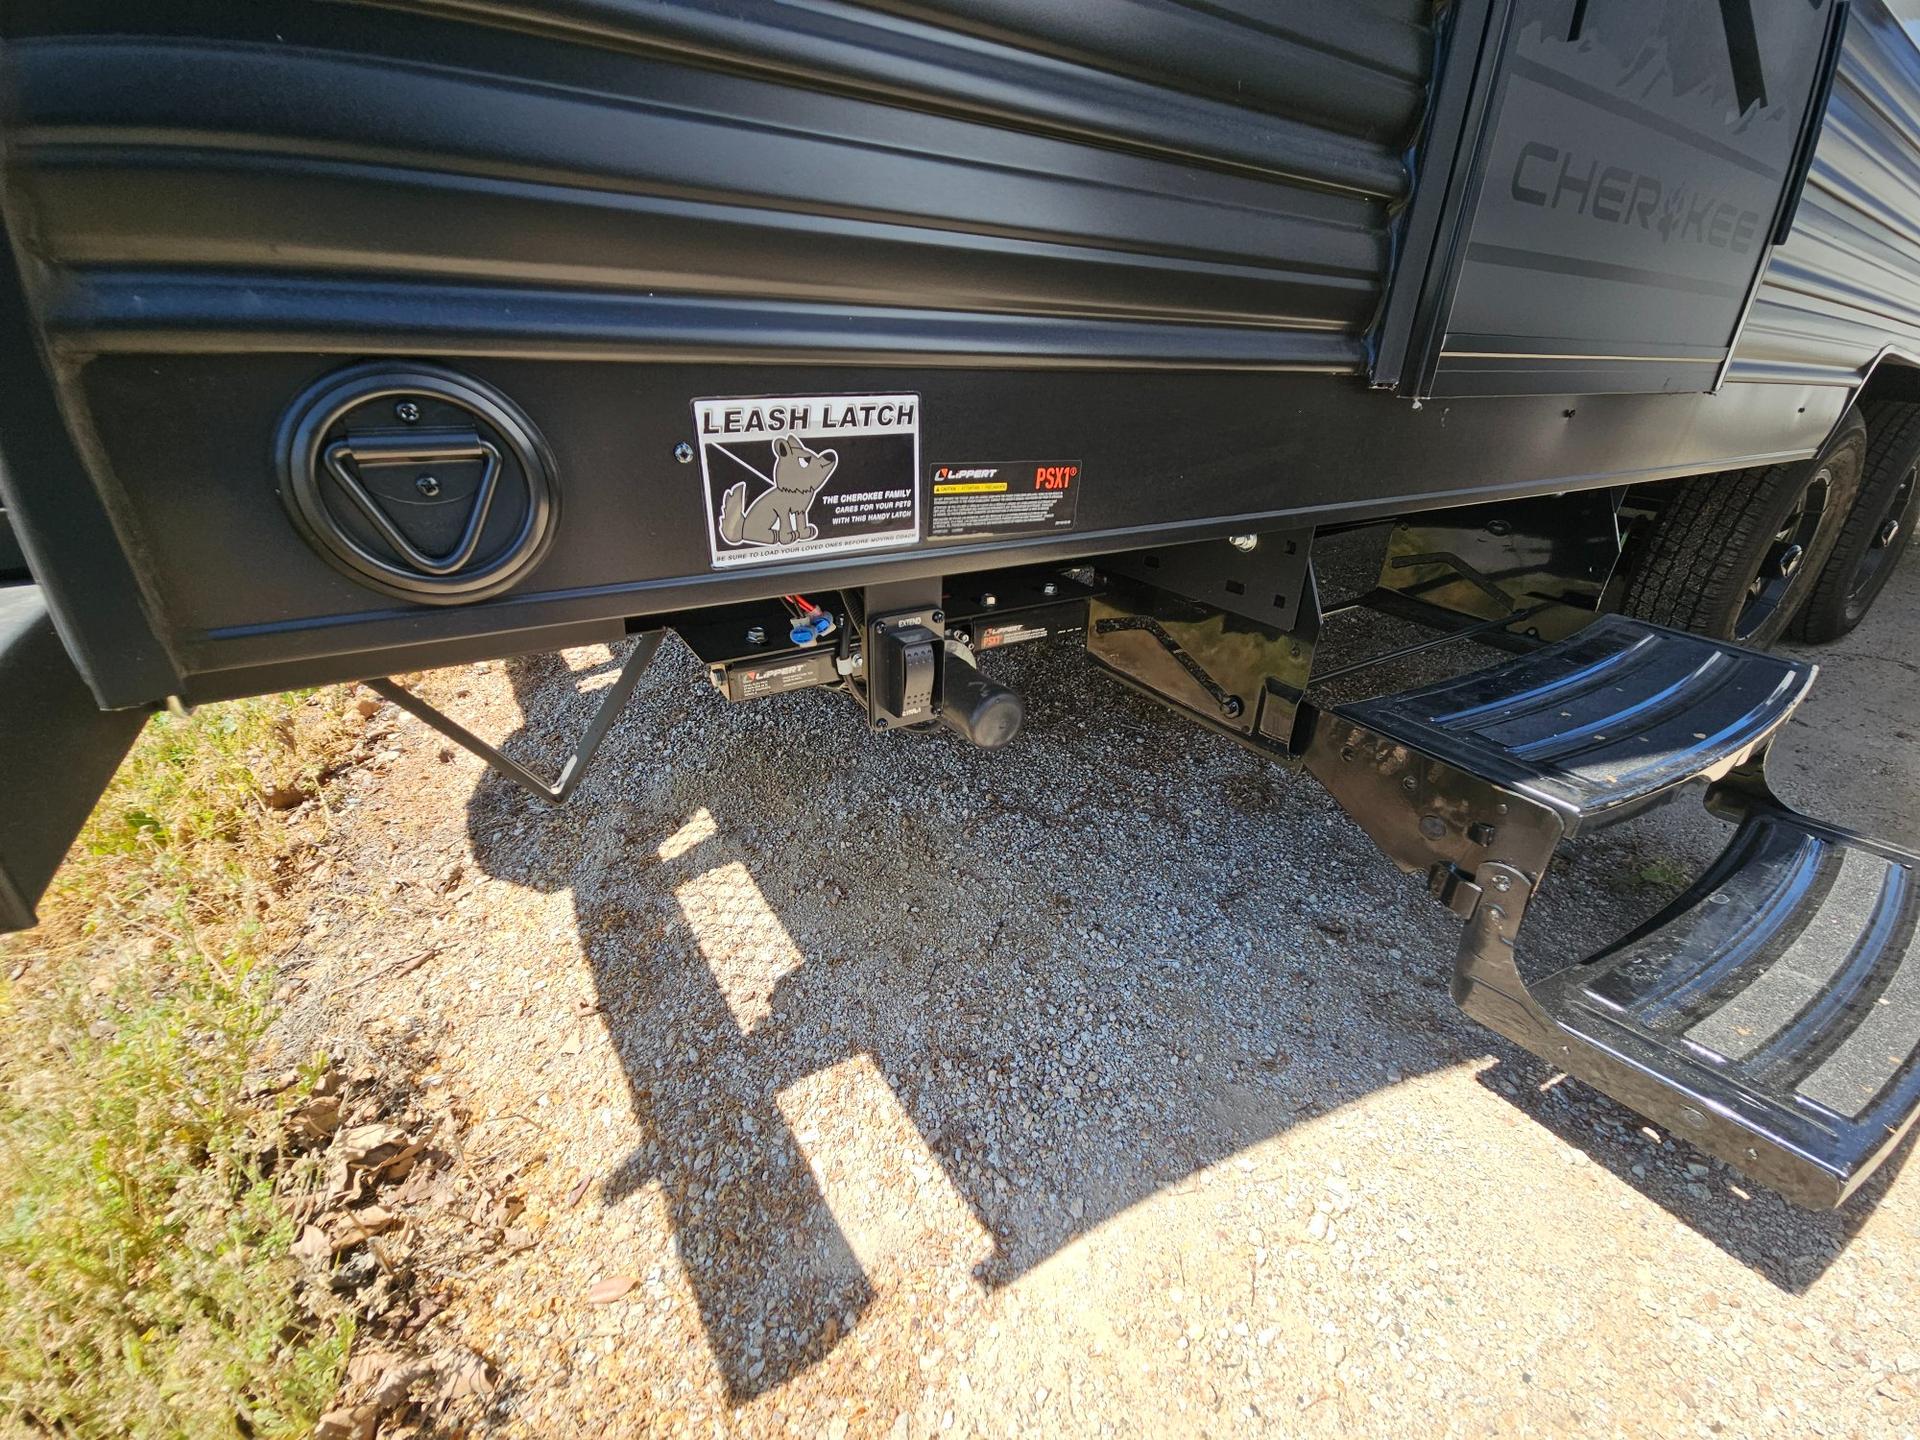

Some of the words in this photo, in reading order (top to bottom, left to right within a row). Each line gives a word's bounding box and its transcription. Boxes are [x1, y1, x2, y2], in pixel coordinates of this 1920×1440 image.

[703, 407, 811, 434] LEASH
[822, 404, 915, 429] LATCH
[822, 495, 839, 505] THE
[840, 491, 883, 503] CHEROKEE
[884, 489, 912, 499] FAMILY
[835, 504, 859, 514] CARES
[859, 503, 874, 512] FOR
[875, 501, 894, 510] YOUR
[895, 500, 912, 509] PETS
[832, 516, 850, 525] WITH
[851, 514, 867, 523] THIS
[867, 512, 890, 521] HANDY
[891, 510, 912, 519] LATCH
[716, 554, 726, 562] BE
[728, 552, 747, 560] SURE
[750, 550, 759, 558] TO
[760, 549, 779, 557] LOAD
[781, 547, 800, 555] YOUR
[801, 543, 824, 552] LOVED
[825, 541, 842, 549] ONES
[844, 538, 869, 547] BEFORE
[871, 536, 894, 544] MOVING
[898, 617, 921, 628] EXTEND
